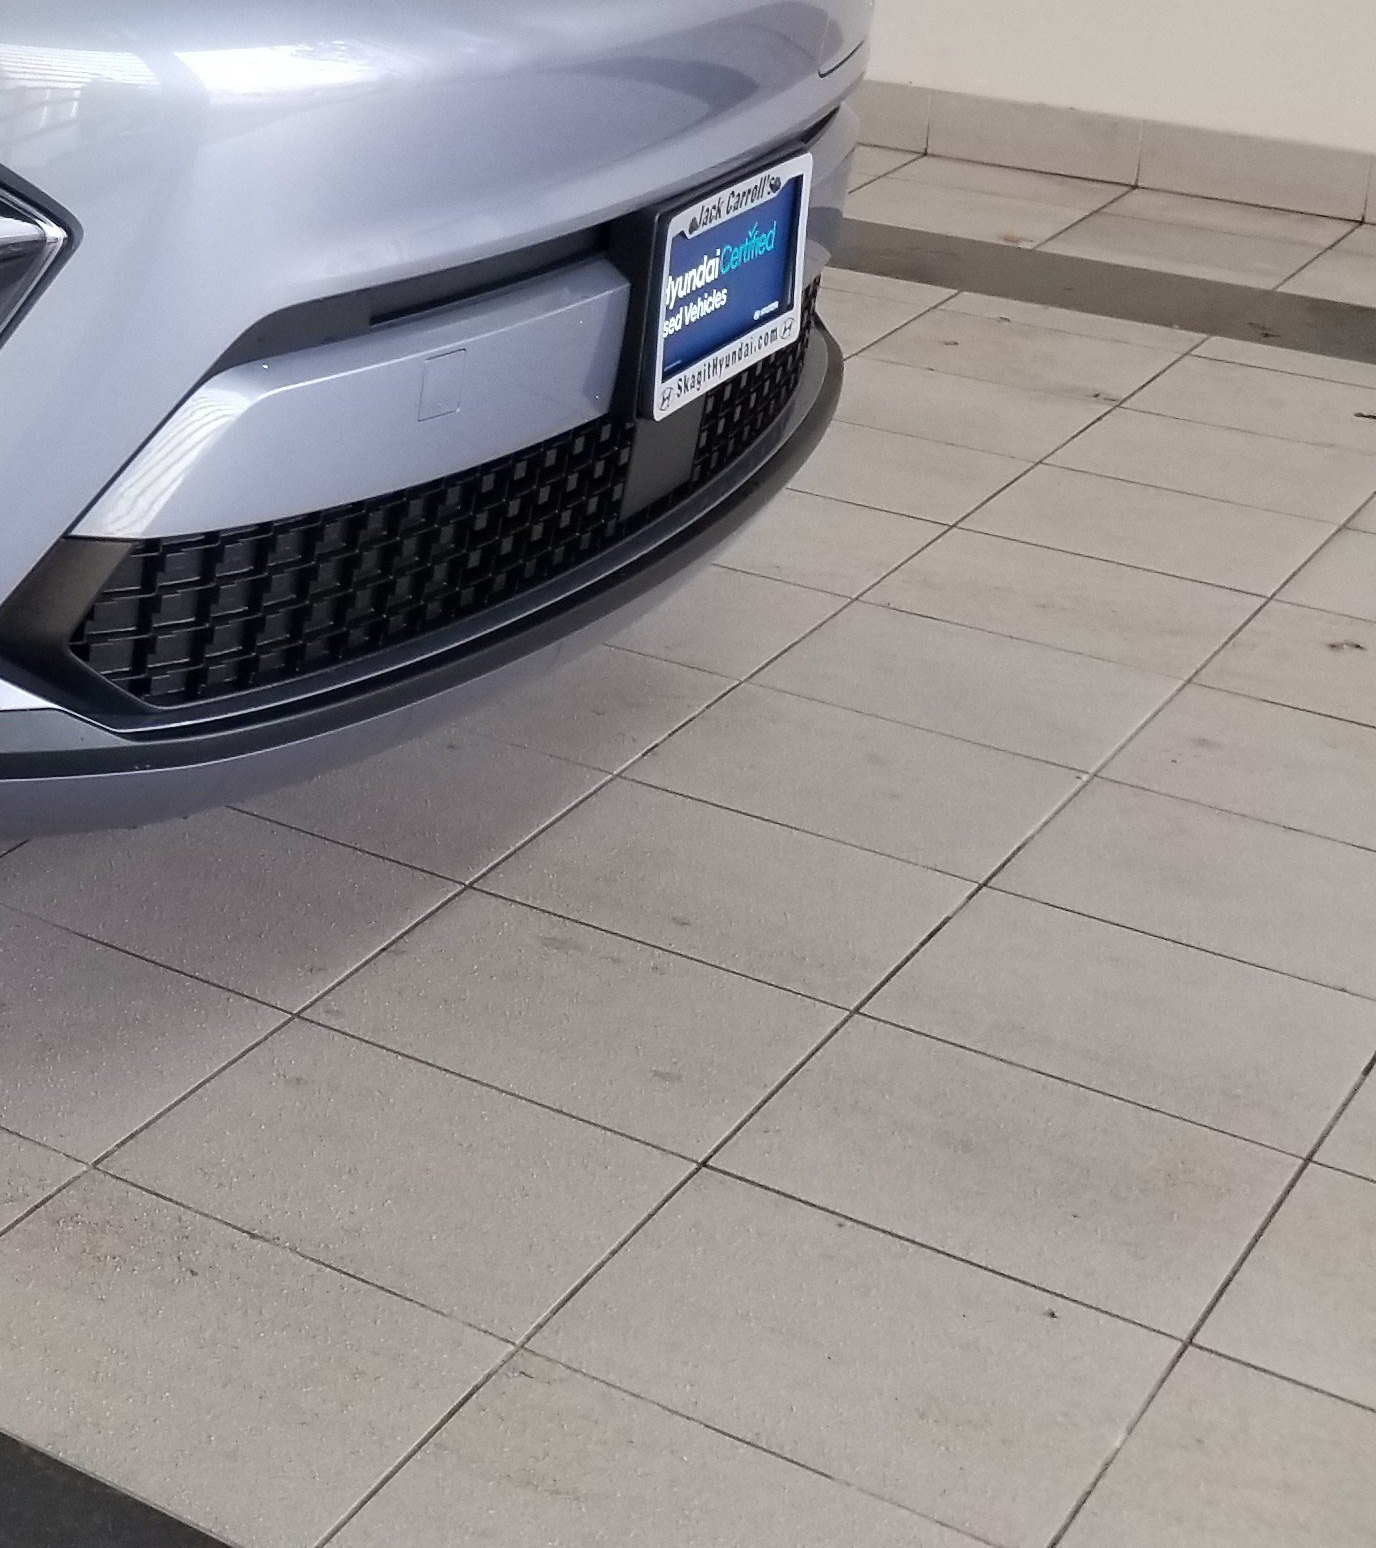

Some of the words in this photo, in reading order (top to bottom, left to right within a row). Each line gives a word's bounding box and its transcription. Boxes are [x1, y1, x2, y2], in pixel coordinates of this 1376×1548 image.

[697, 196, 724, 228] Jack
[726, 174, 774, 215] Carroll's
[662, 306, 683, 338] sed
[683, 288, 728, 326] Vehicles
[676, 326, 778, 399] SkagitHyundai.com
